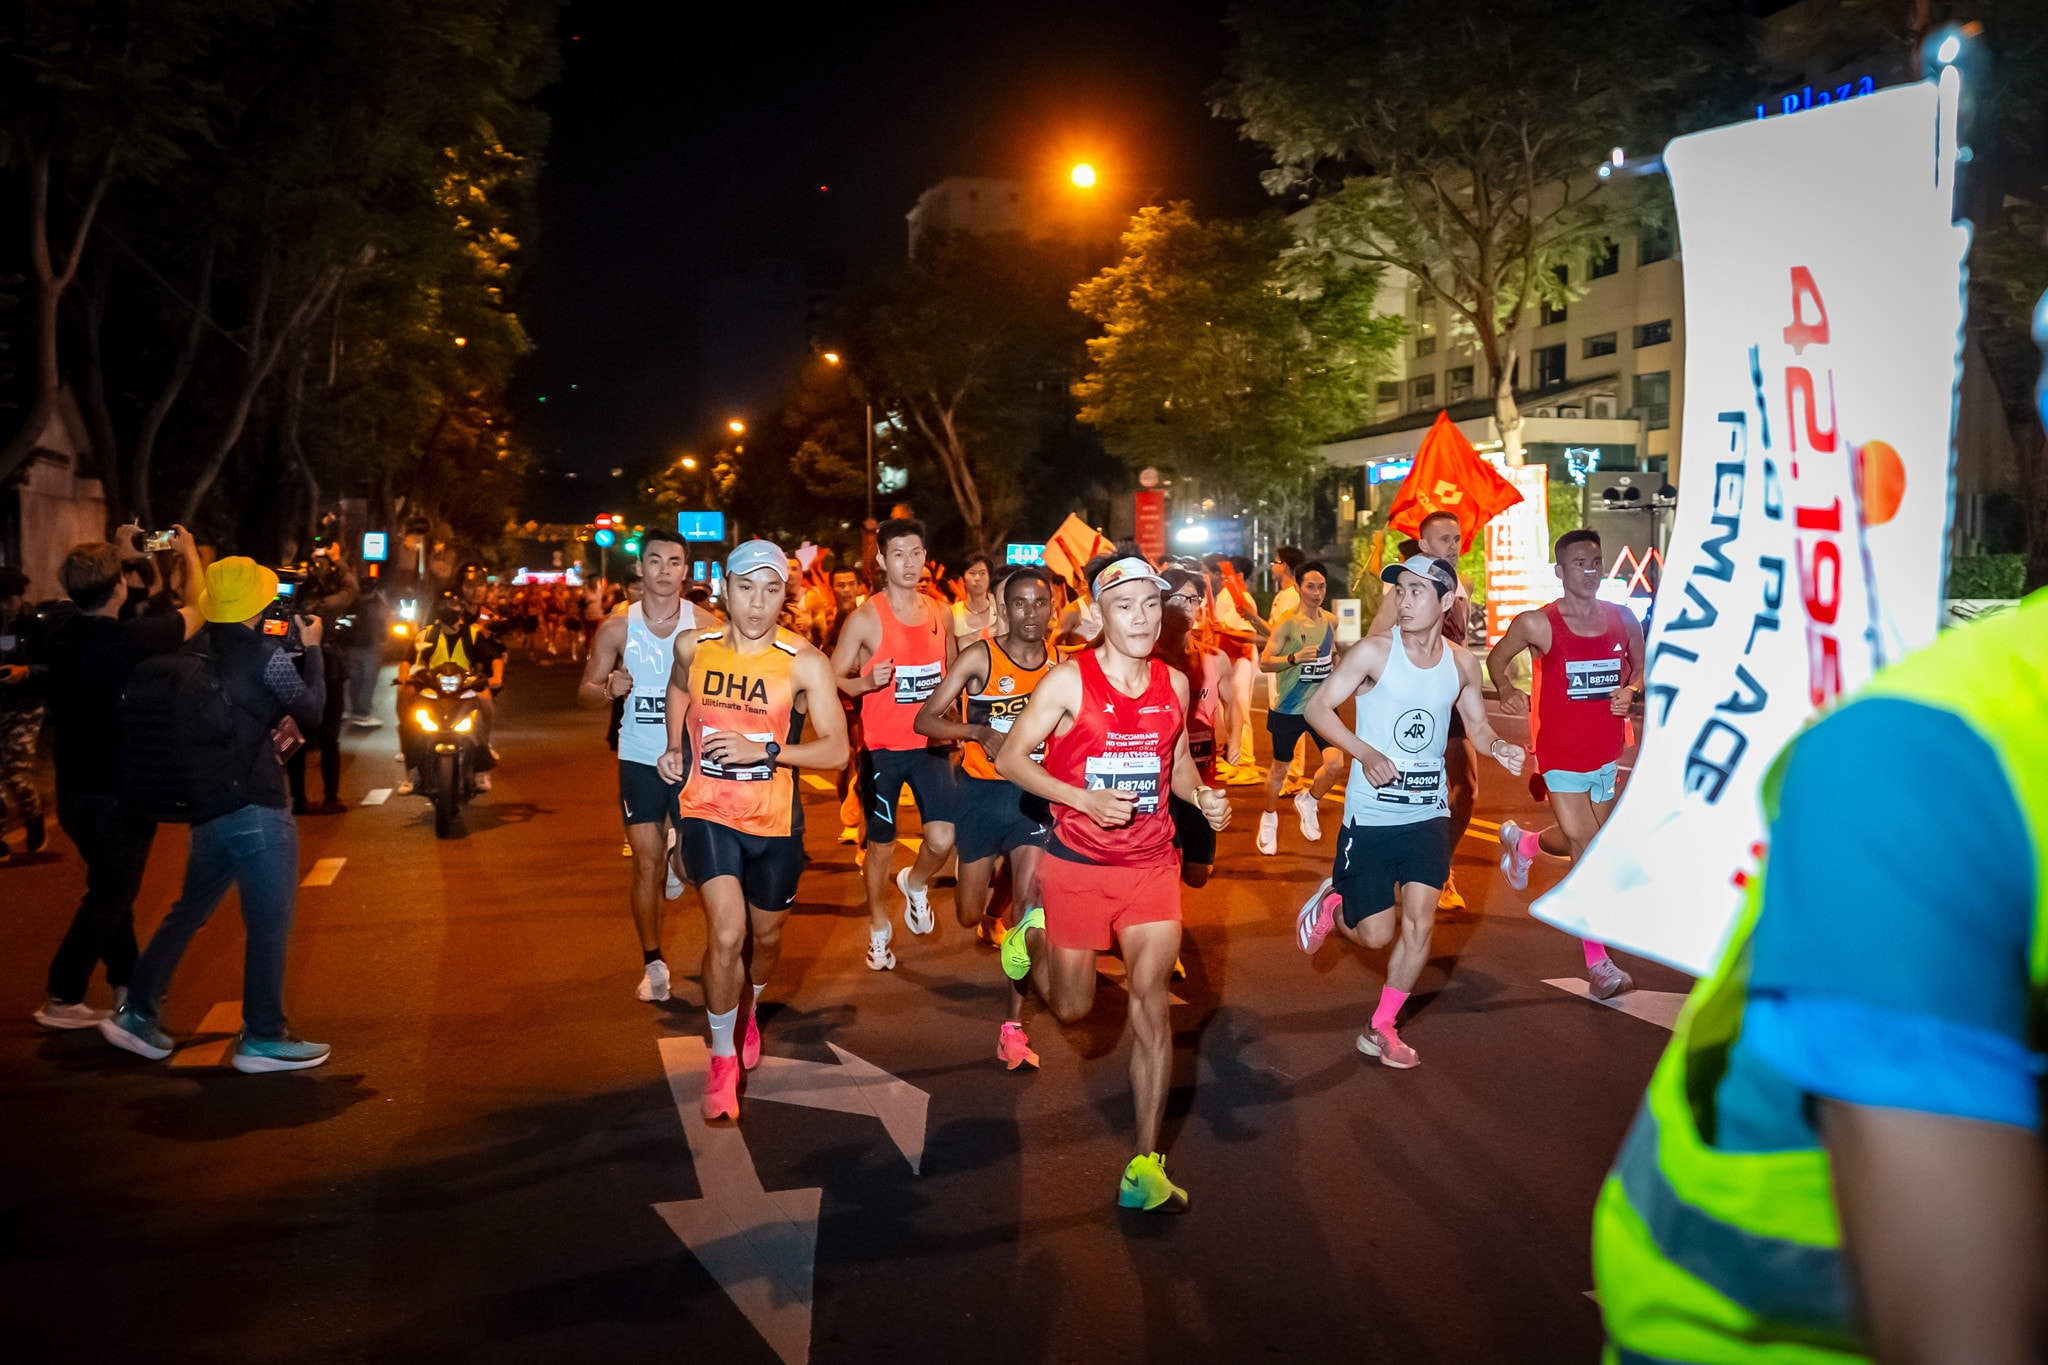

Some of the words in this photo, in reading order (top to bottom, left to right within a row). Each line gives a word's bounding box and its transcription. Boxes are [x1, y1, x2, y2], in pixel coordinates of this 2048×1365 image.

[1782, 75, 1875, 114] Plaza
[1304, 665, 1312, 674] C
[900, 678, 911, 690] A
[1572, 675, 1583, 686] A
[1589, 673, 1619, 685] 887403
[703, 670, 769, 705] DHA
[639, 698, 651, 710] A
[744, 703, 768, 715] Team
[989, 697, 1029, 716] DE
[1106, 732, 1159, 741] TECHCOMBANK
[1091, 777, 1106, 791] A
[1117, 779, 1156, 791] 887401
[1406, 775, 1438, 785] 940104
